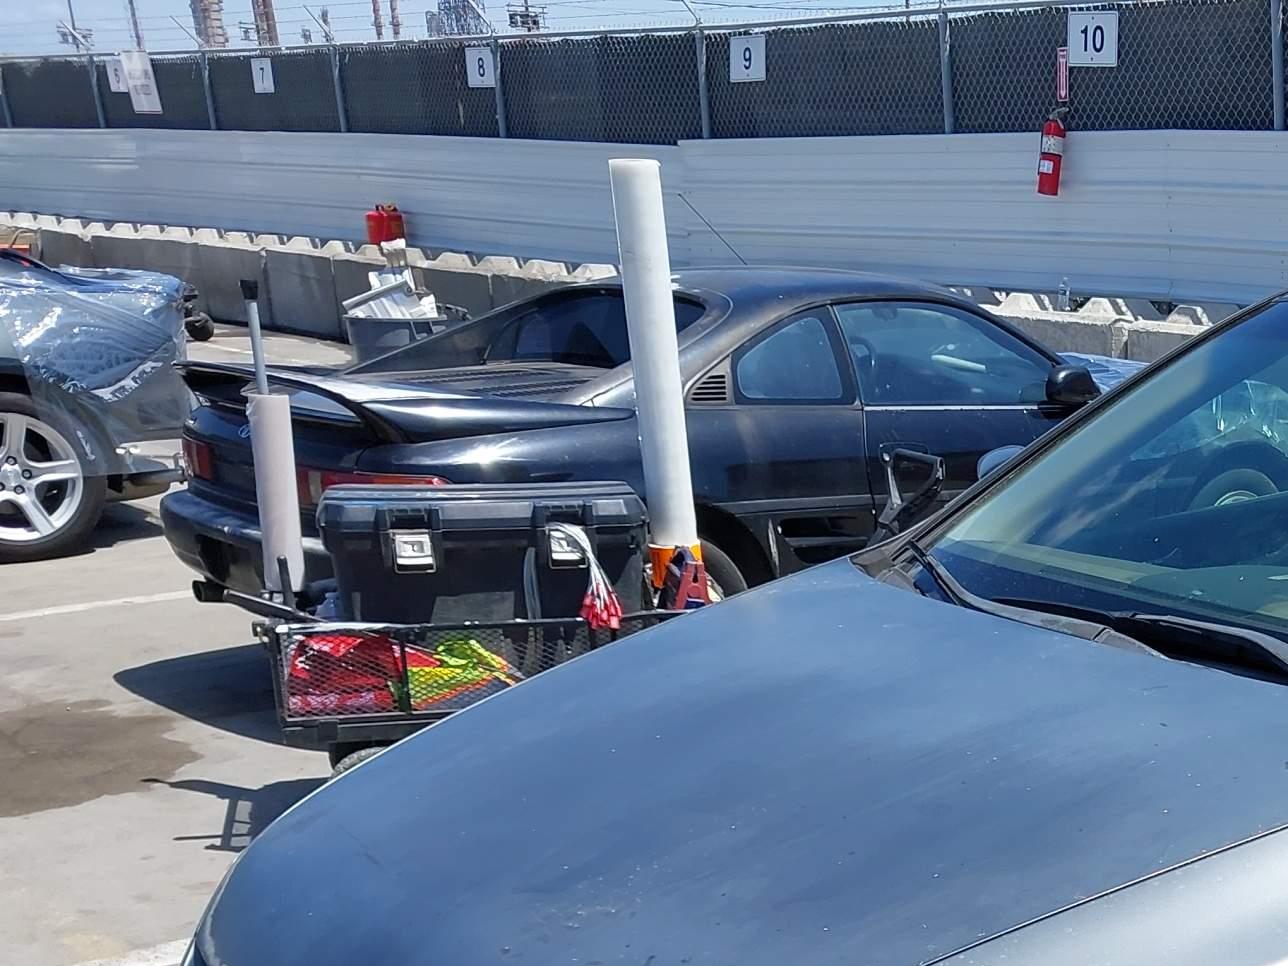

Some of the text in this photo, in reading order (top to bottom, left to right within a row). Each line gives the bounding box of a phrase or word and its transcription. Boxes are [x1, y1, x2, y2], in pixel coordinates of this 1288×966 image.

[1080, 24, 1105, 53] 10
[477, 57, 486, 77] 8
[743, 46, 752, 70] 9
[259, 67, 265, 85] 7
